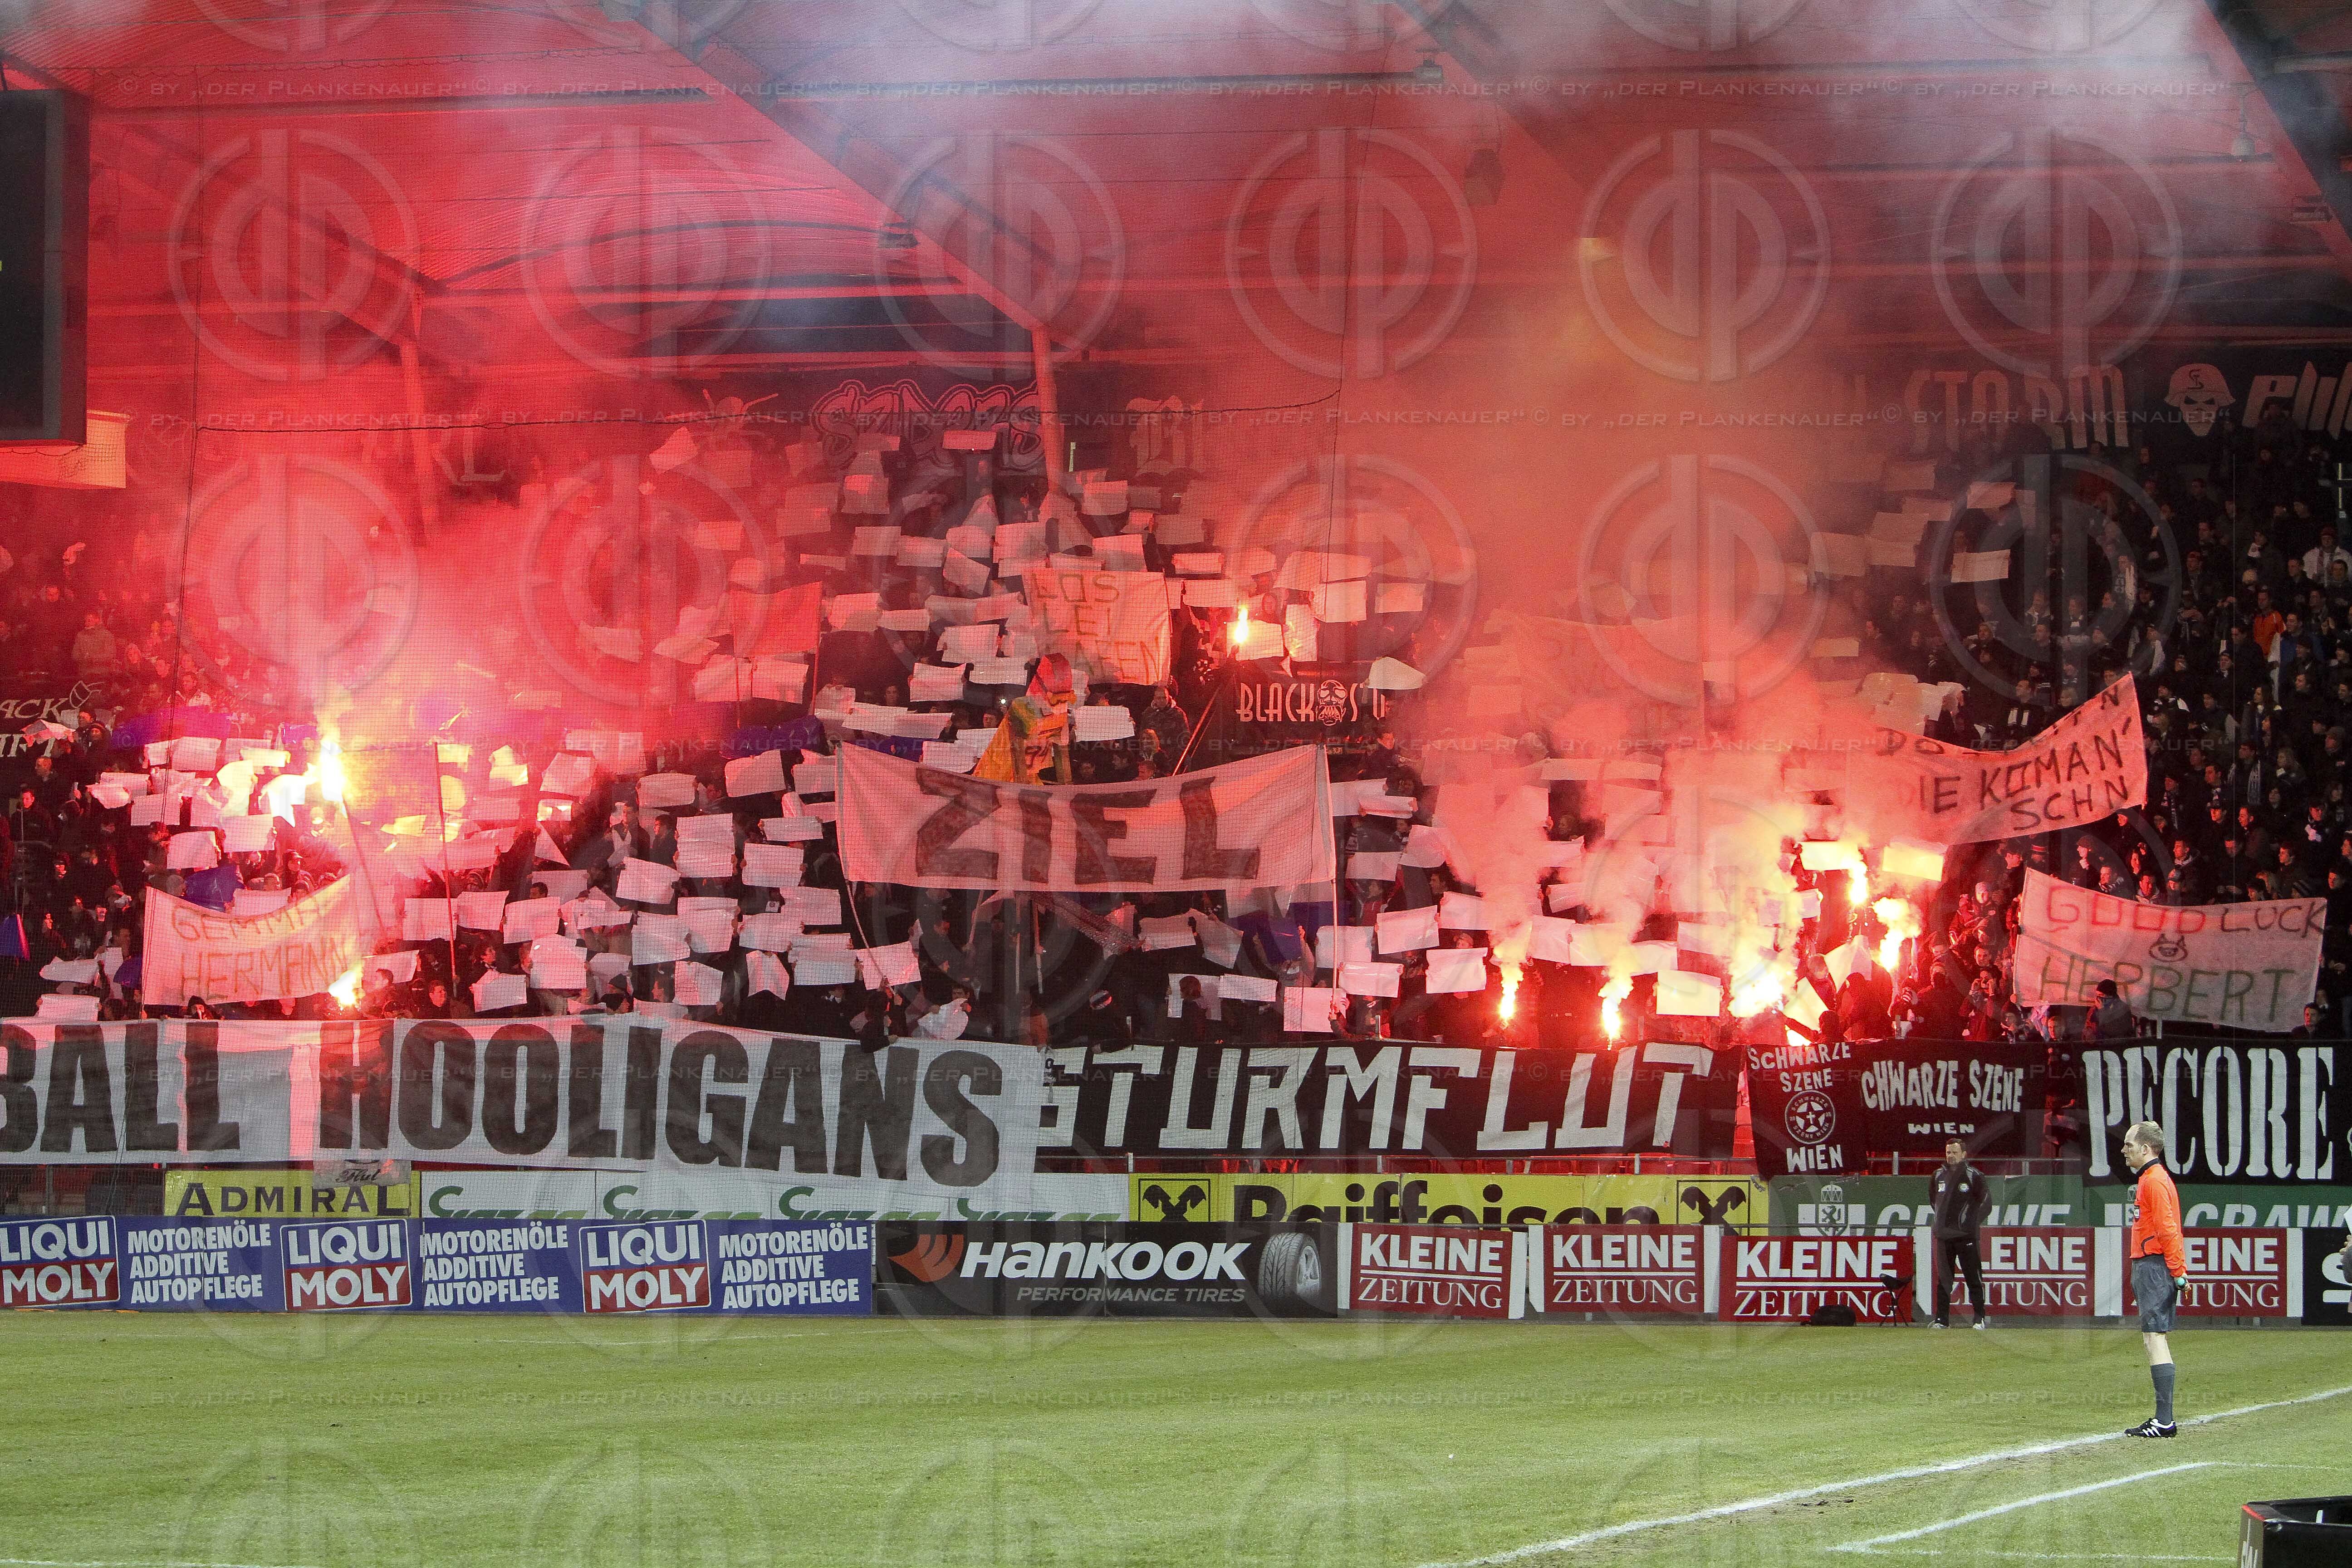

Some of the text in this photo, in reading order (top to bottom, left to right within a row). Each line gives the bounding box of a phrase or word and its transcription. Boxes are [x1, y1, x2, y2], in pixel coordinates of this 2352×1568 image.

[1032, 573, 1120, 603] LOS
[1235, 682, 1315, 722] BLACK
[2011, 775, 2129, 831] SCHN
[915, 767, 1260, 885] ZIEL
[2048, 886, 2328, 938] GOOD LUCK
[180, 936, 349, 1000] HERMANN
[2039, 956, 2298, 1023] HERBERT
[1748, 1042, 1851, 1070] SCHWARZE
[1780, 1068, 1833, 1093] SZENE
[1969, 1059, 2024, 1113] SZENE
[319, 1020, 1002, 1187] HOOLIGANS
[1907, 1122, 1975, 1135] WIEN
[1786, 1144, 1843, 1172] WIEN
[176, 1182, 409, 1216] ADMIRAL
[1, 1220, 109, 1261] LIQUI
[128, 1220, 271, 1254] MOTORENÖLE
[288, 1223, 402, 1264] LIQUI
[420, 1221, 568, 1257] MOTORENÖLE
[587, 1224, 700, 1267] LIQUI
[719, 1222, 868, 1258] MOTORENÖLE
[1361, 1233, 1503, 1274] KLEINE
[1553, 1235, 1695, 1268] KLEINE
[1955, 1236, 2086, 1271] EINE
[2185, 1237, 2278, 1271] EINE
[130, 1251, 228, 1279] ADDITIVE
[423, 1253, 524, 1283] ADDITIVE
[721, 1254, 824, 1284] ADDITIVE
[1736, 1240, 1897, 1278] KLEINE
[3, 1261, 116, 1304] MOLY
[131, 1274, 263, 1304] AUTOPFLEGE
[292, 1266, 407, 1307] MOLY
[424, 1276, 559, 1307] AUTOPFLEGE
[589, 1266, 705, 1309] MOLY
[722, 1279, 859, 1309] AUTOPFLEGE
[1016, 1287, 1245, 1303] PERFORMANCE TIRES
[1359, 1277, 1503, 1309] ZEITUNG
[1552, 1278, 1697, 1303] ZEITUNG
[2178, 1283, 2280, 1308] TUNG
[1734, 1289, 1898, 1318] ZEITUNG
